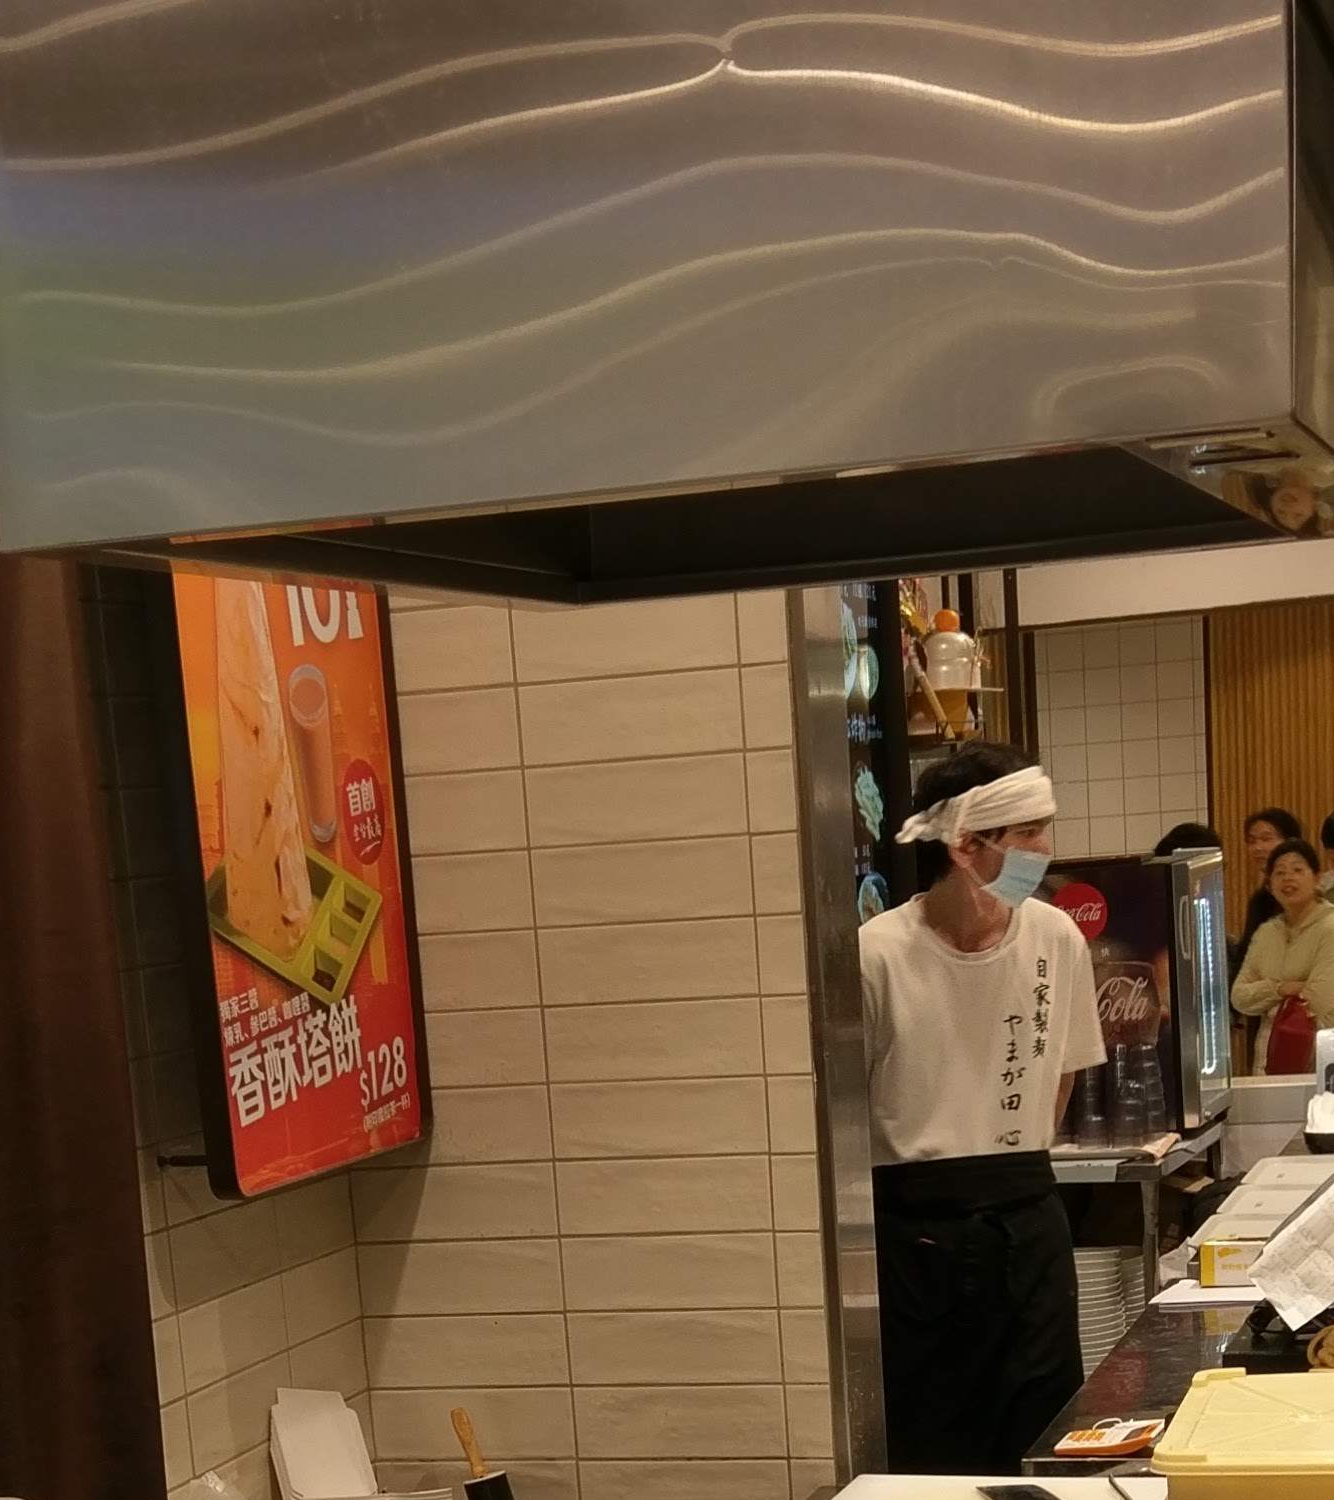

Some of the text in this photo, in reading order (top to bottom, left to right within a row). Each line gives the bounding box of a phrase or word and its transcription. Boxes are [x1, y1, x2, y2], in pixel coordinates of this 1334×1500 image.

[228, 994, 364, 1129] 香酥塔餅
[359, 1035, 408, 1113] $128
